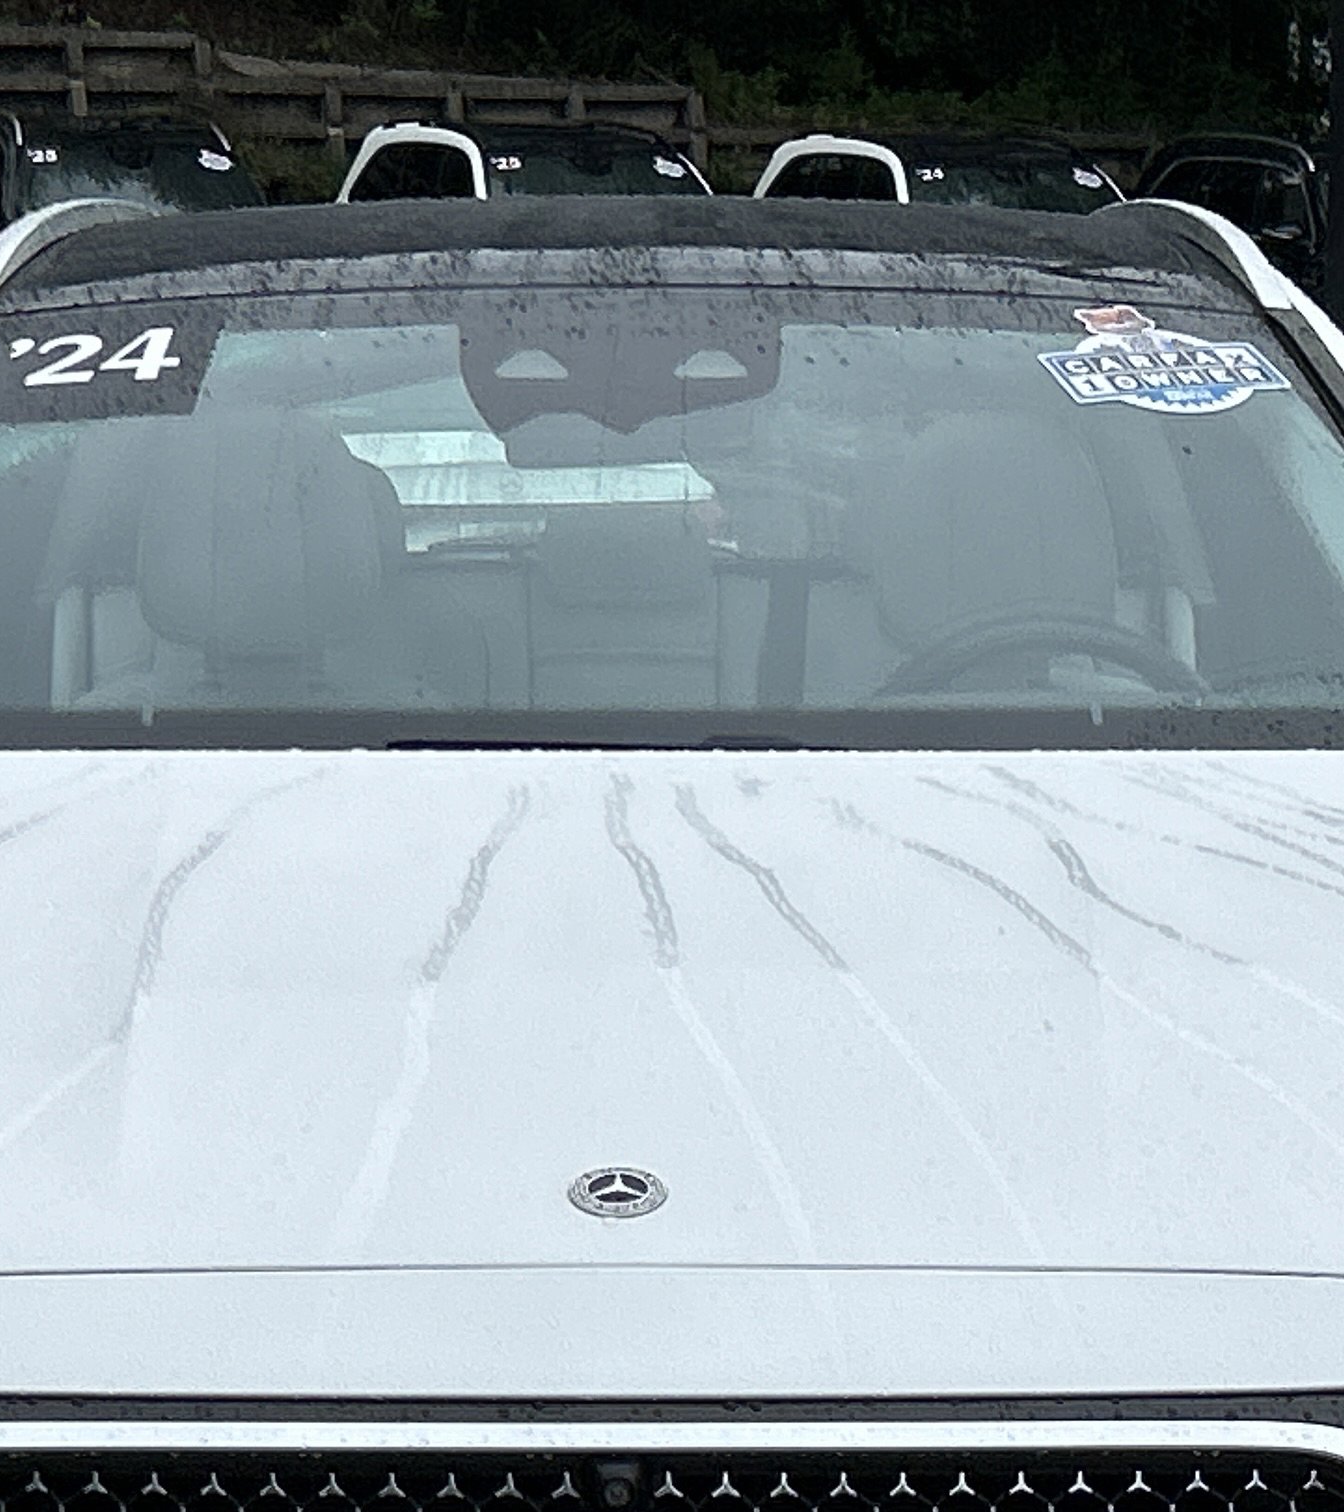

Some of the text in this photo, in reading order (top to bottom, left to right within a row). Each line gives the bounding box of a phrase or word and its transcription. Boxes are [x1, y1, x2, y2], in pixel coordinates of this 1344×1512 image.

[9, 327, 181, 387] '24
[1064, 348, 1257, 374] CARFAX
[1112, 366, 1266, 390] OWNER
